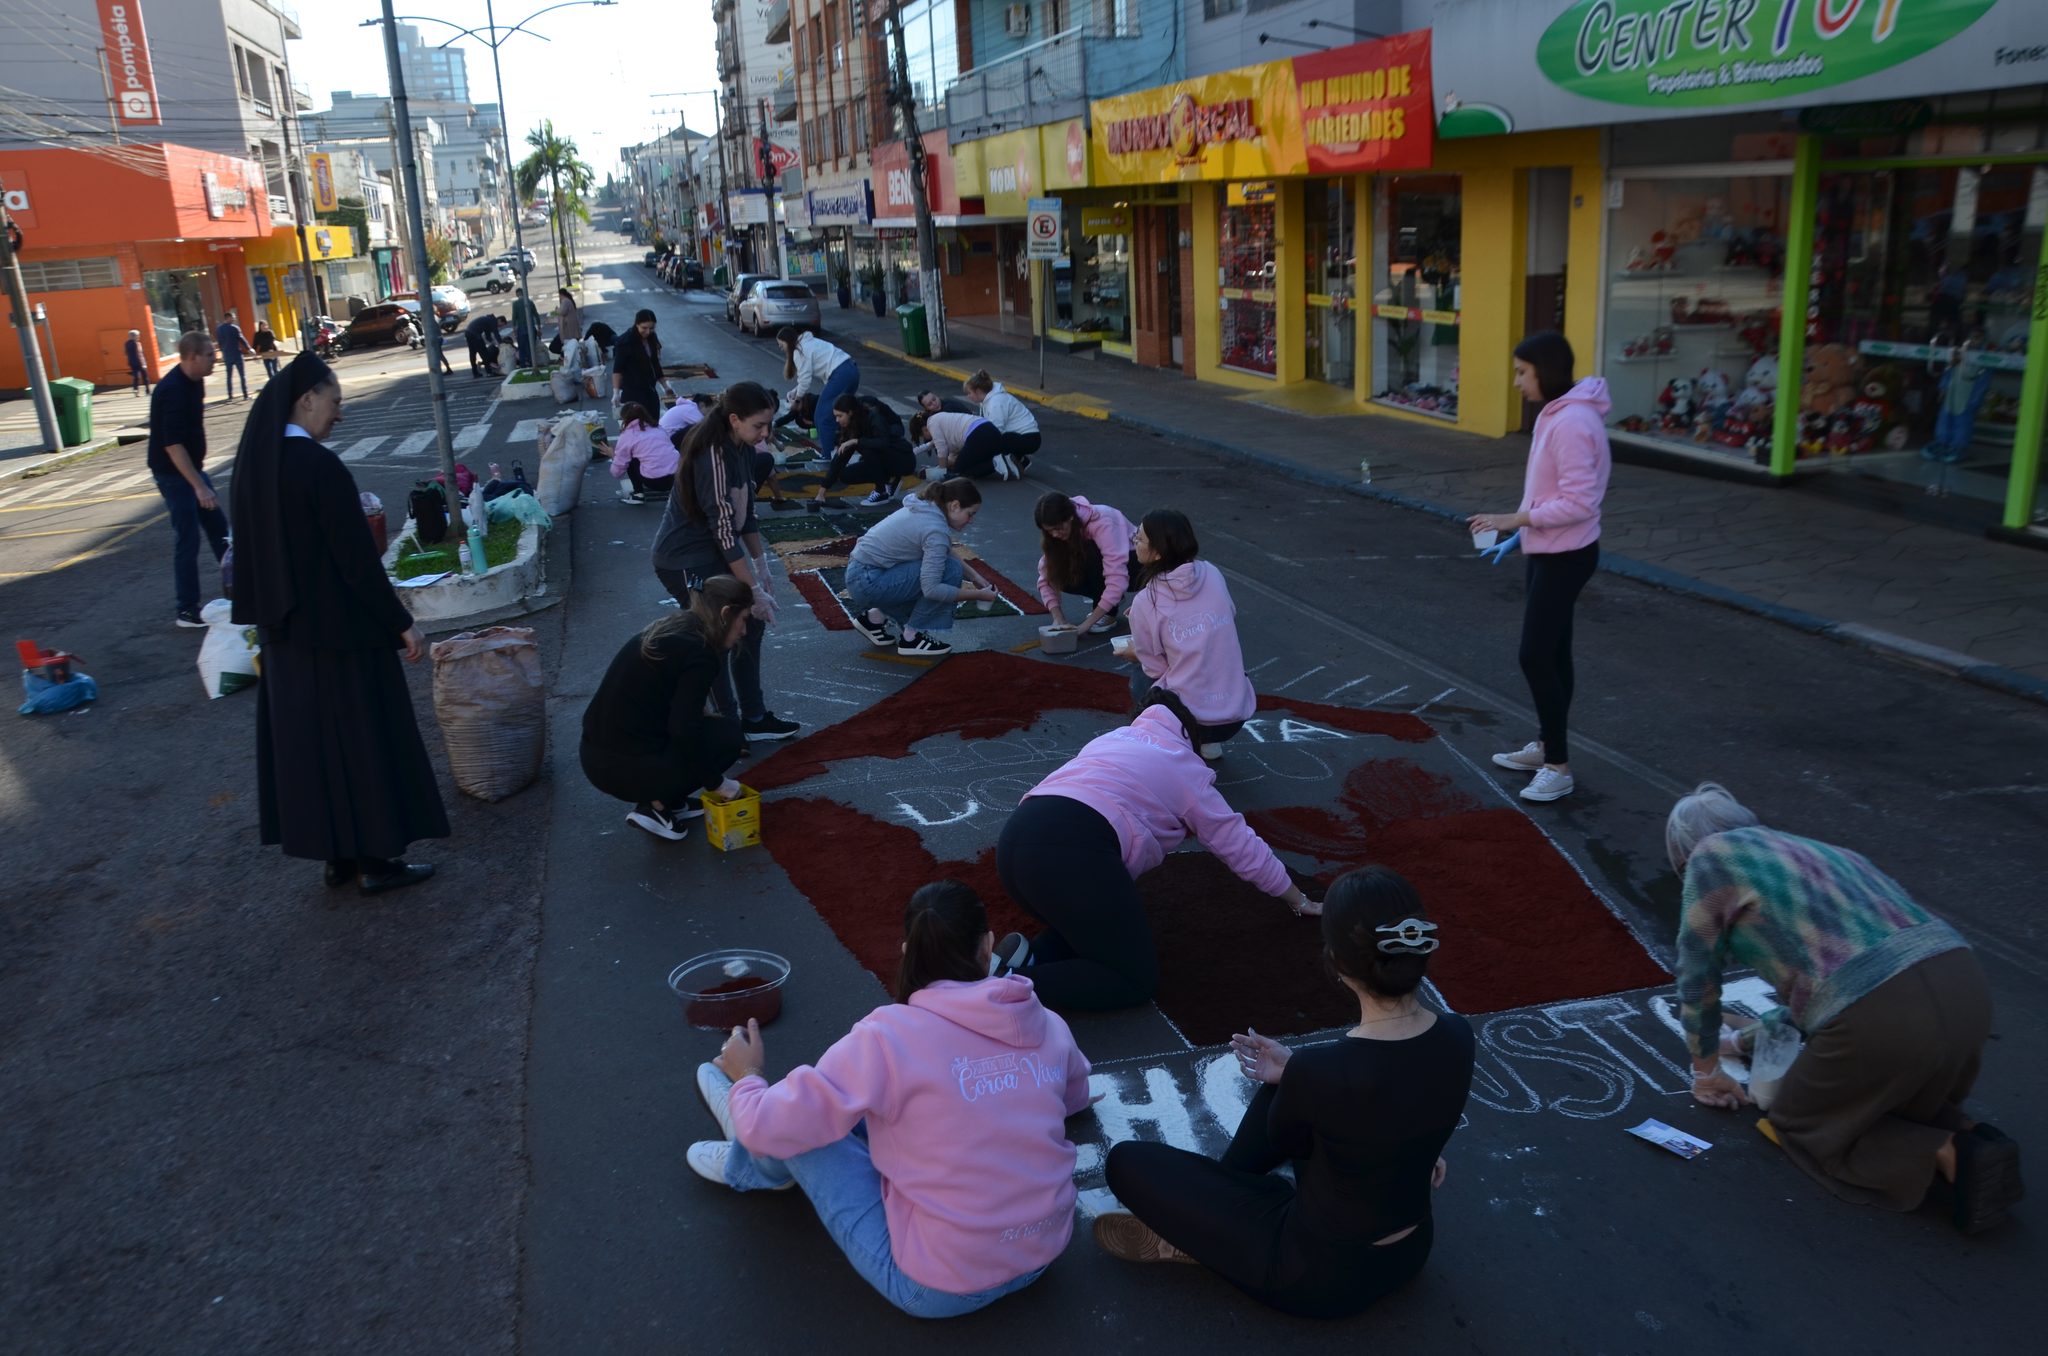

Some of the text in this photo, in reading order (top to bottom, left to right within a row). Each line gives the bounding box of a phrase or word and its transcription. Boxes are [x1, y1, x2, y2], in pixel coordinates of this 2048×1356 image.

[1575, 0, 1754, 76] CENTER
[1301, 63, 1412, 111] UM MUNDO DE
[1647, 51, 1824, 96] Papelaria & Brinquedos
[1108, 111, 1172, 155] MUNDO
[1306, 106, 1405, 146] VARIEDADES
[989, 165, 1016, 195] MODA
[957, 1067, 1019, 1102] Coroa
